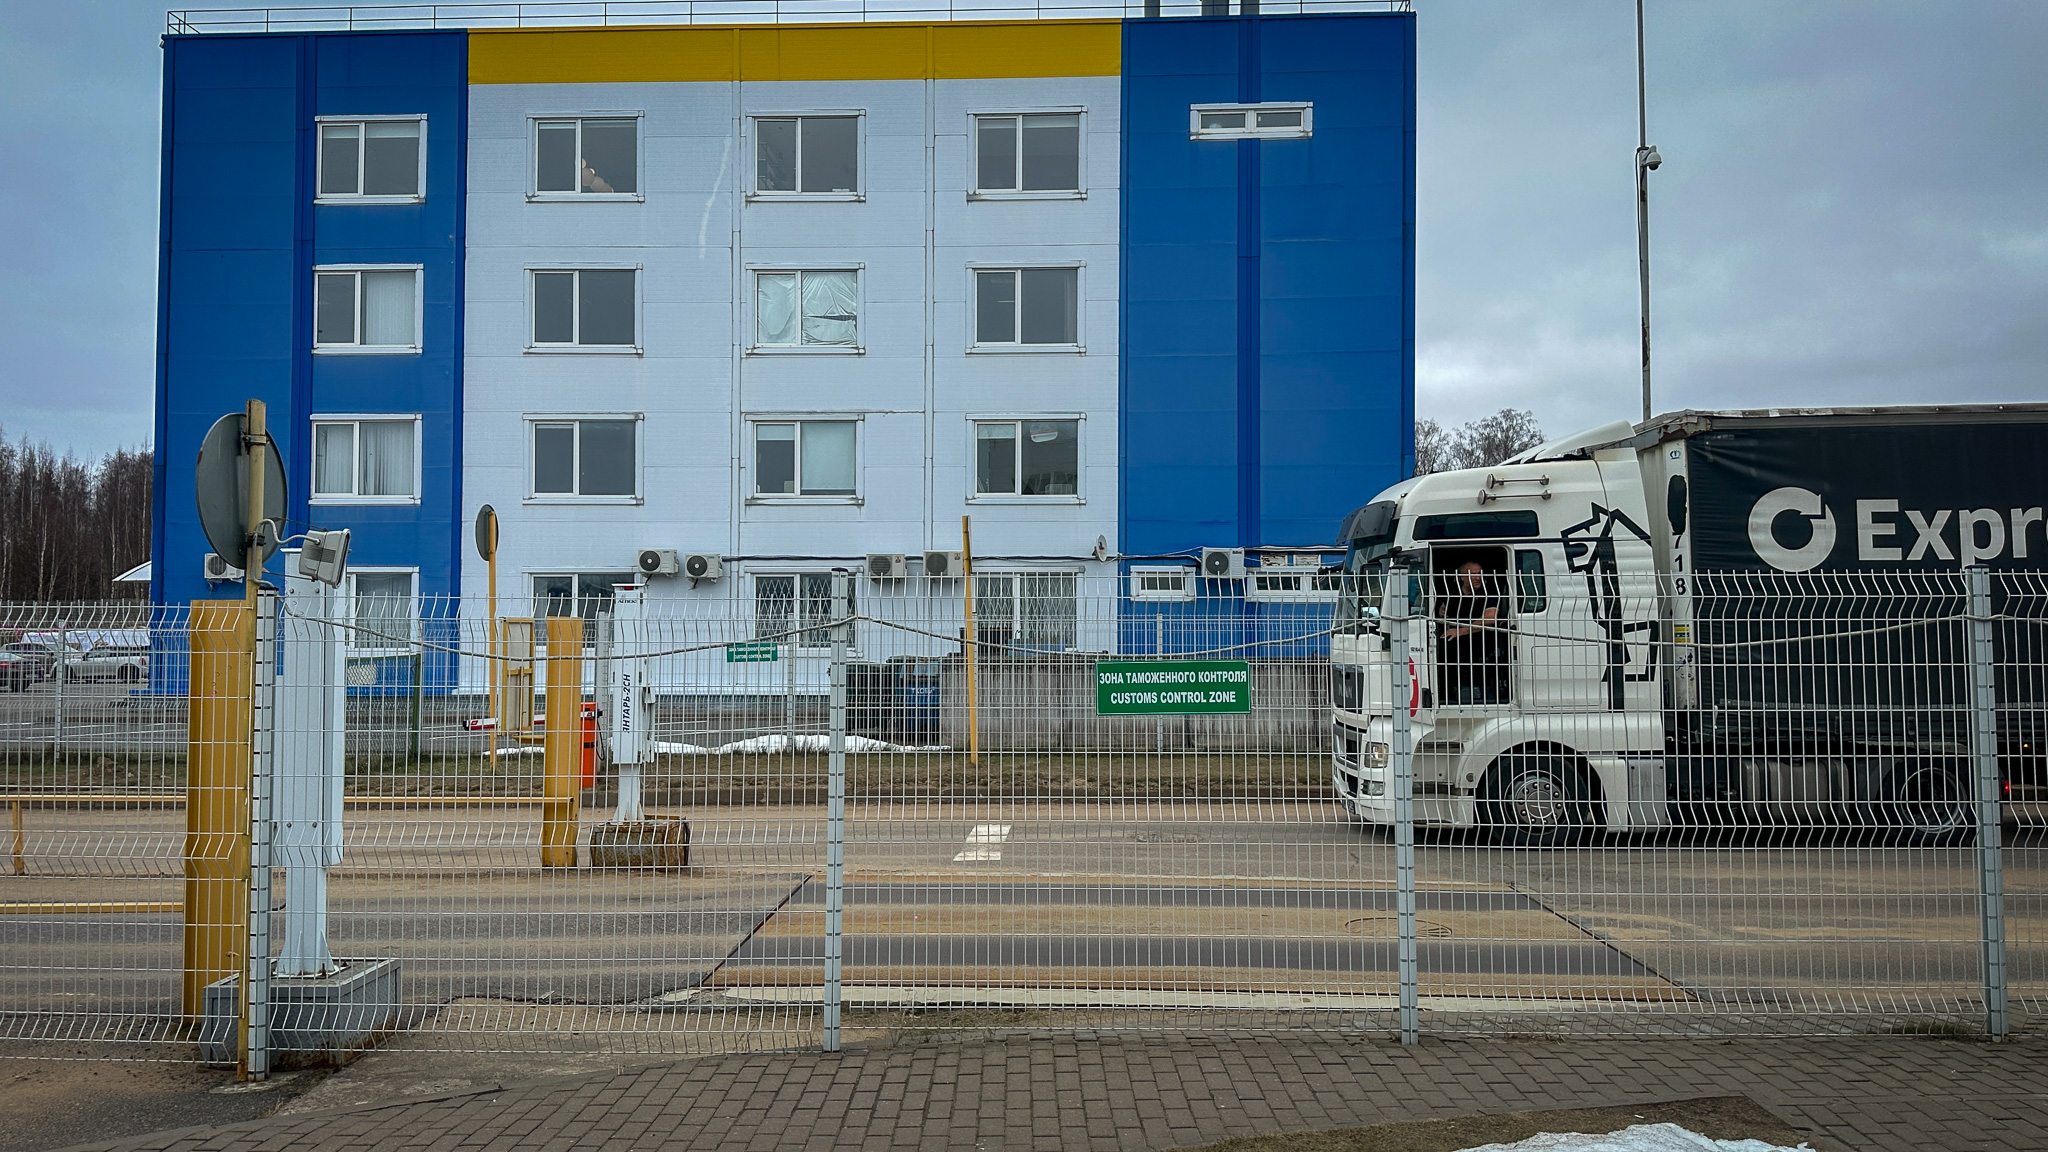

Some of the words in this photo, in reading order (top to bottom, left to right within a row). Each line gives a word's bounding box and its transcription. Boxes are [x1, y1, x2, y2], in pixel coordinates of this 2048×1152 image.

[1856, 498, 2048, 572] Expr
[1099, 672, 1124, 684] ЗОНА
[1126, 671, 1196, 684] ТАМОЖЕННОГО
[1198, 670, 1247, 683] КОНТРОЛЯ
[1110, 692, 1158, 704] CUSTOMS
[1160, 691, 1207, 704] CONTROL
[1208, 691, 1237, 703] ZONE
